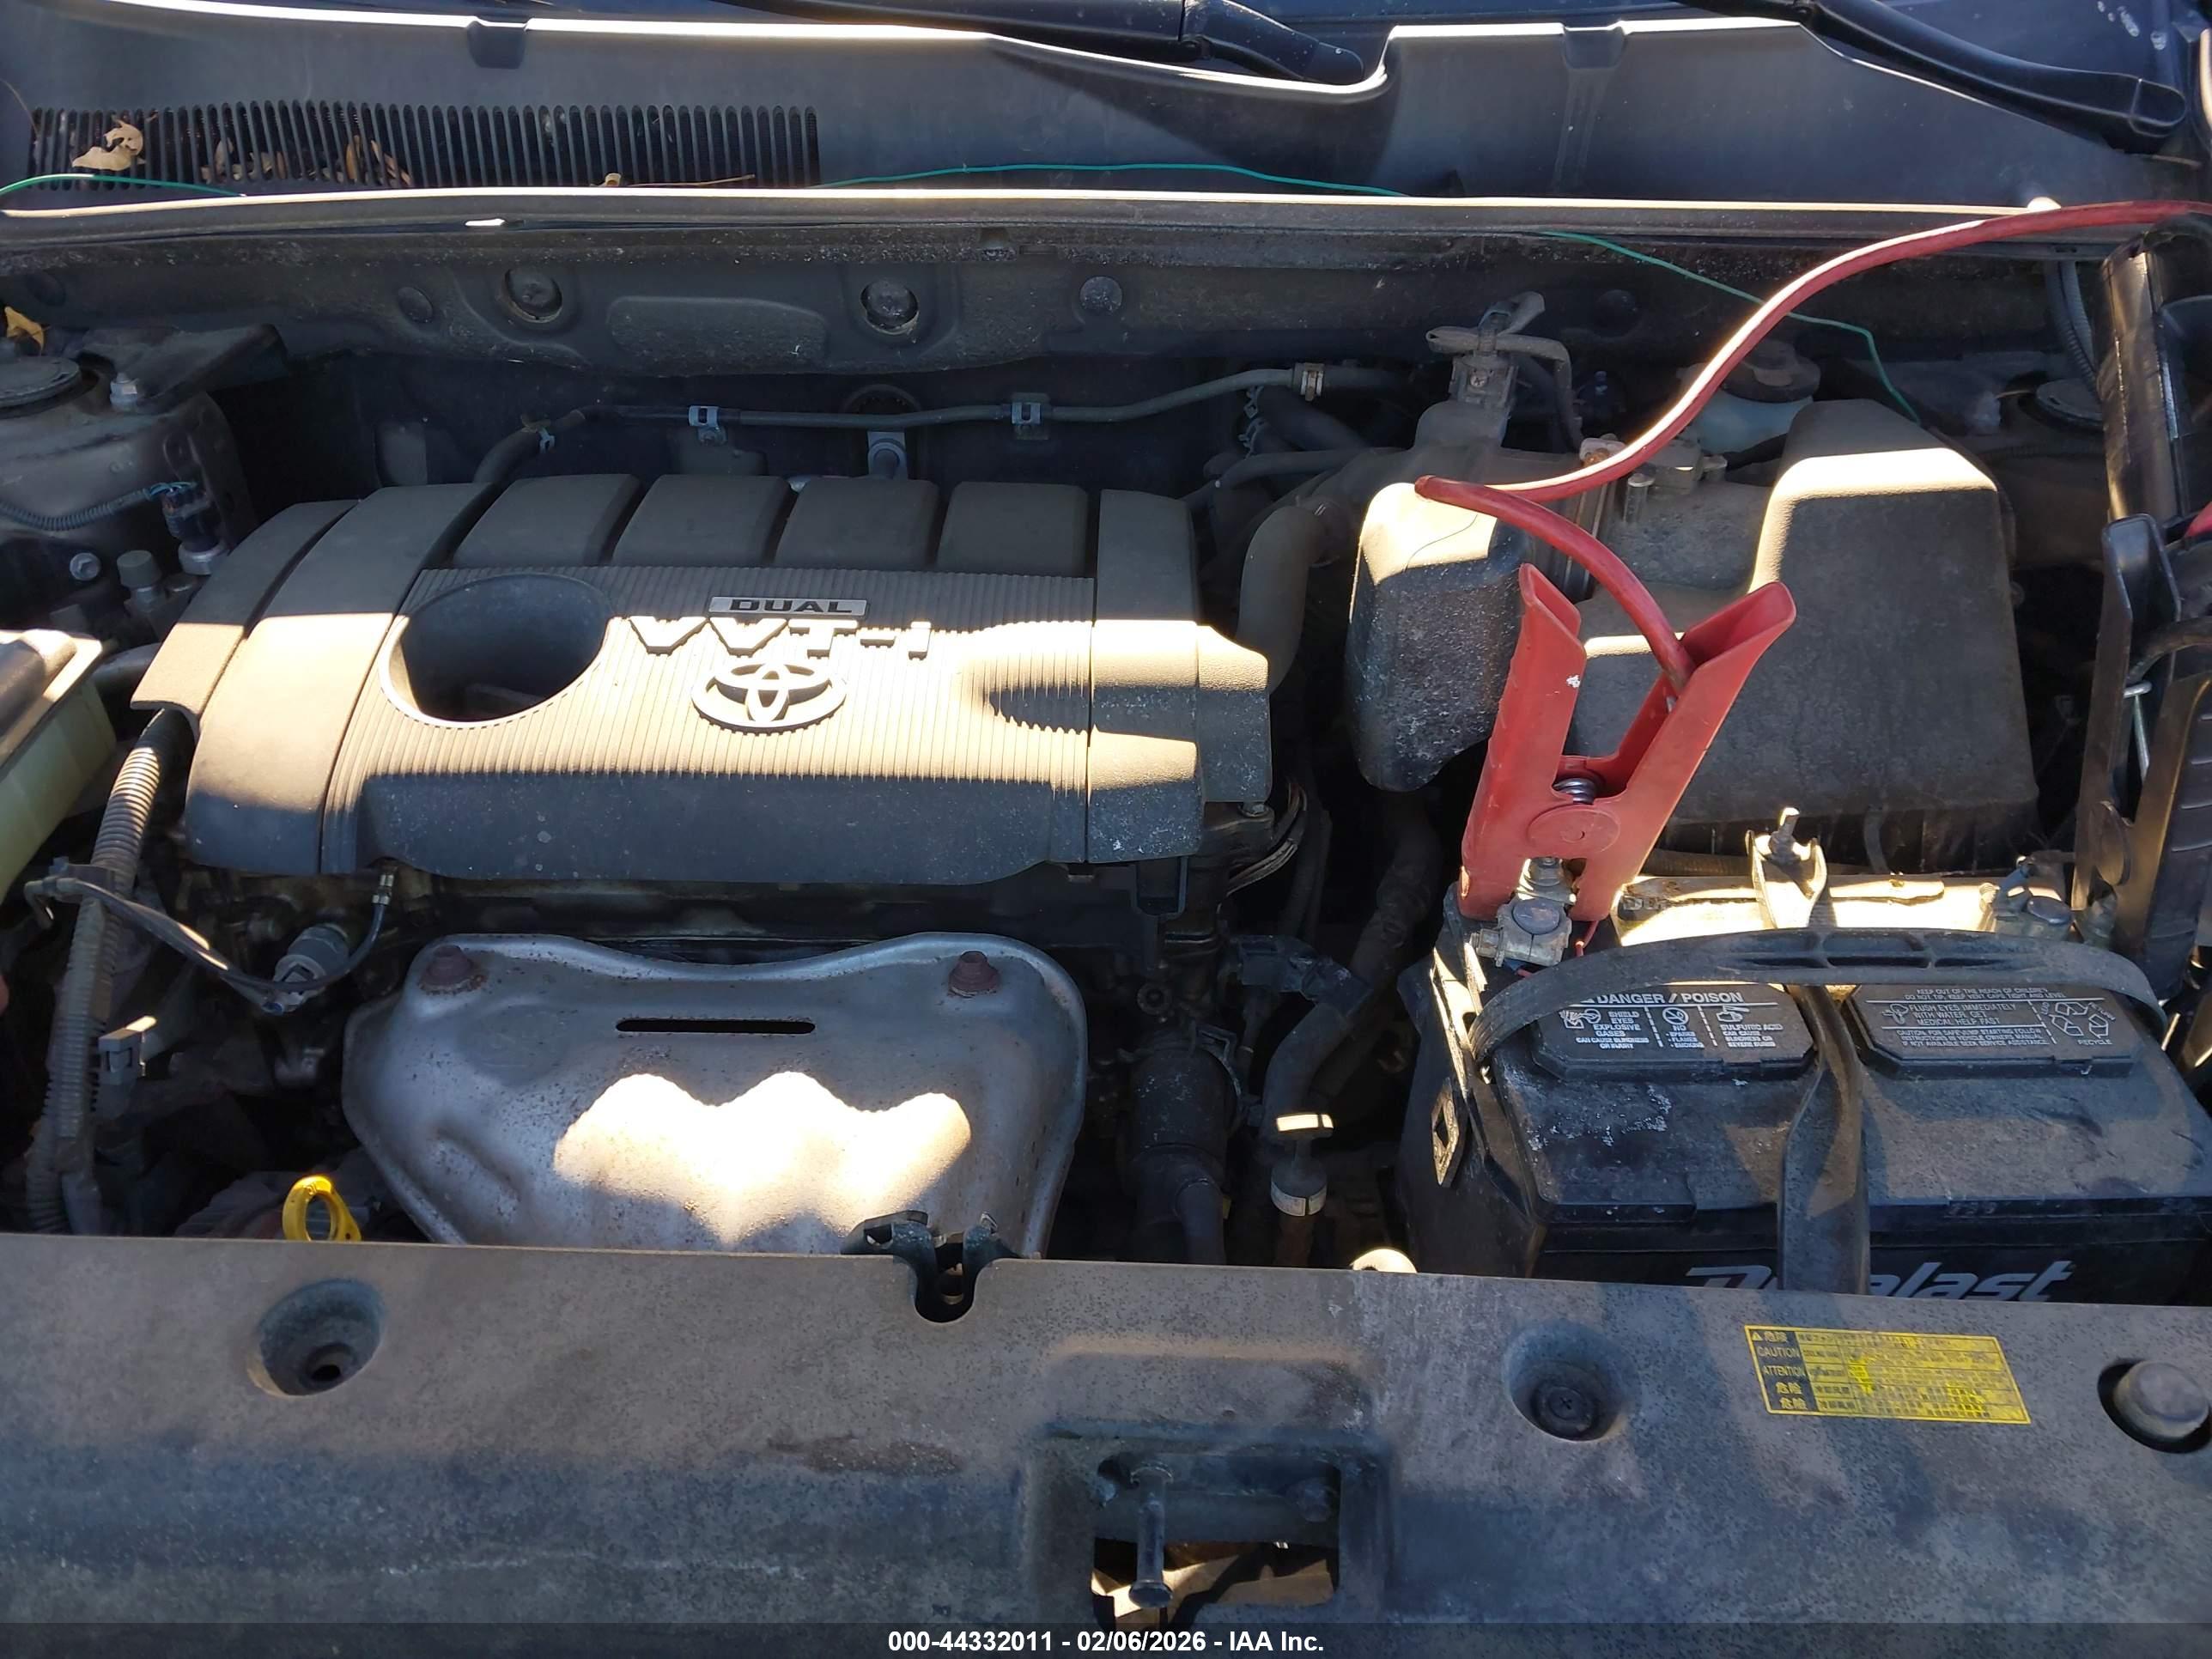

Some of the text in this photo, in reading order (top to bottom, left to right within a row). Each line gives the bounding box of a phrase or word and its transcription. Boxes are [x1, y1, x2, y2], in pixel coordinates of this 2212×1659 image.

[729, 599, 853, 614] DUAL
[1597, 994, 1665, 1004] DANGER
[1680, 992, 1745, 1003] POISON
[1686, 1261, 2073, 1303] Dlast
[1757, 1346, 1801, 1358] CAUTION
[1762, 1364, 1808, 1377] ATTENTION
